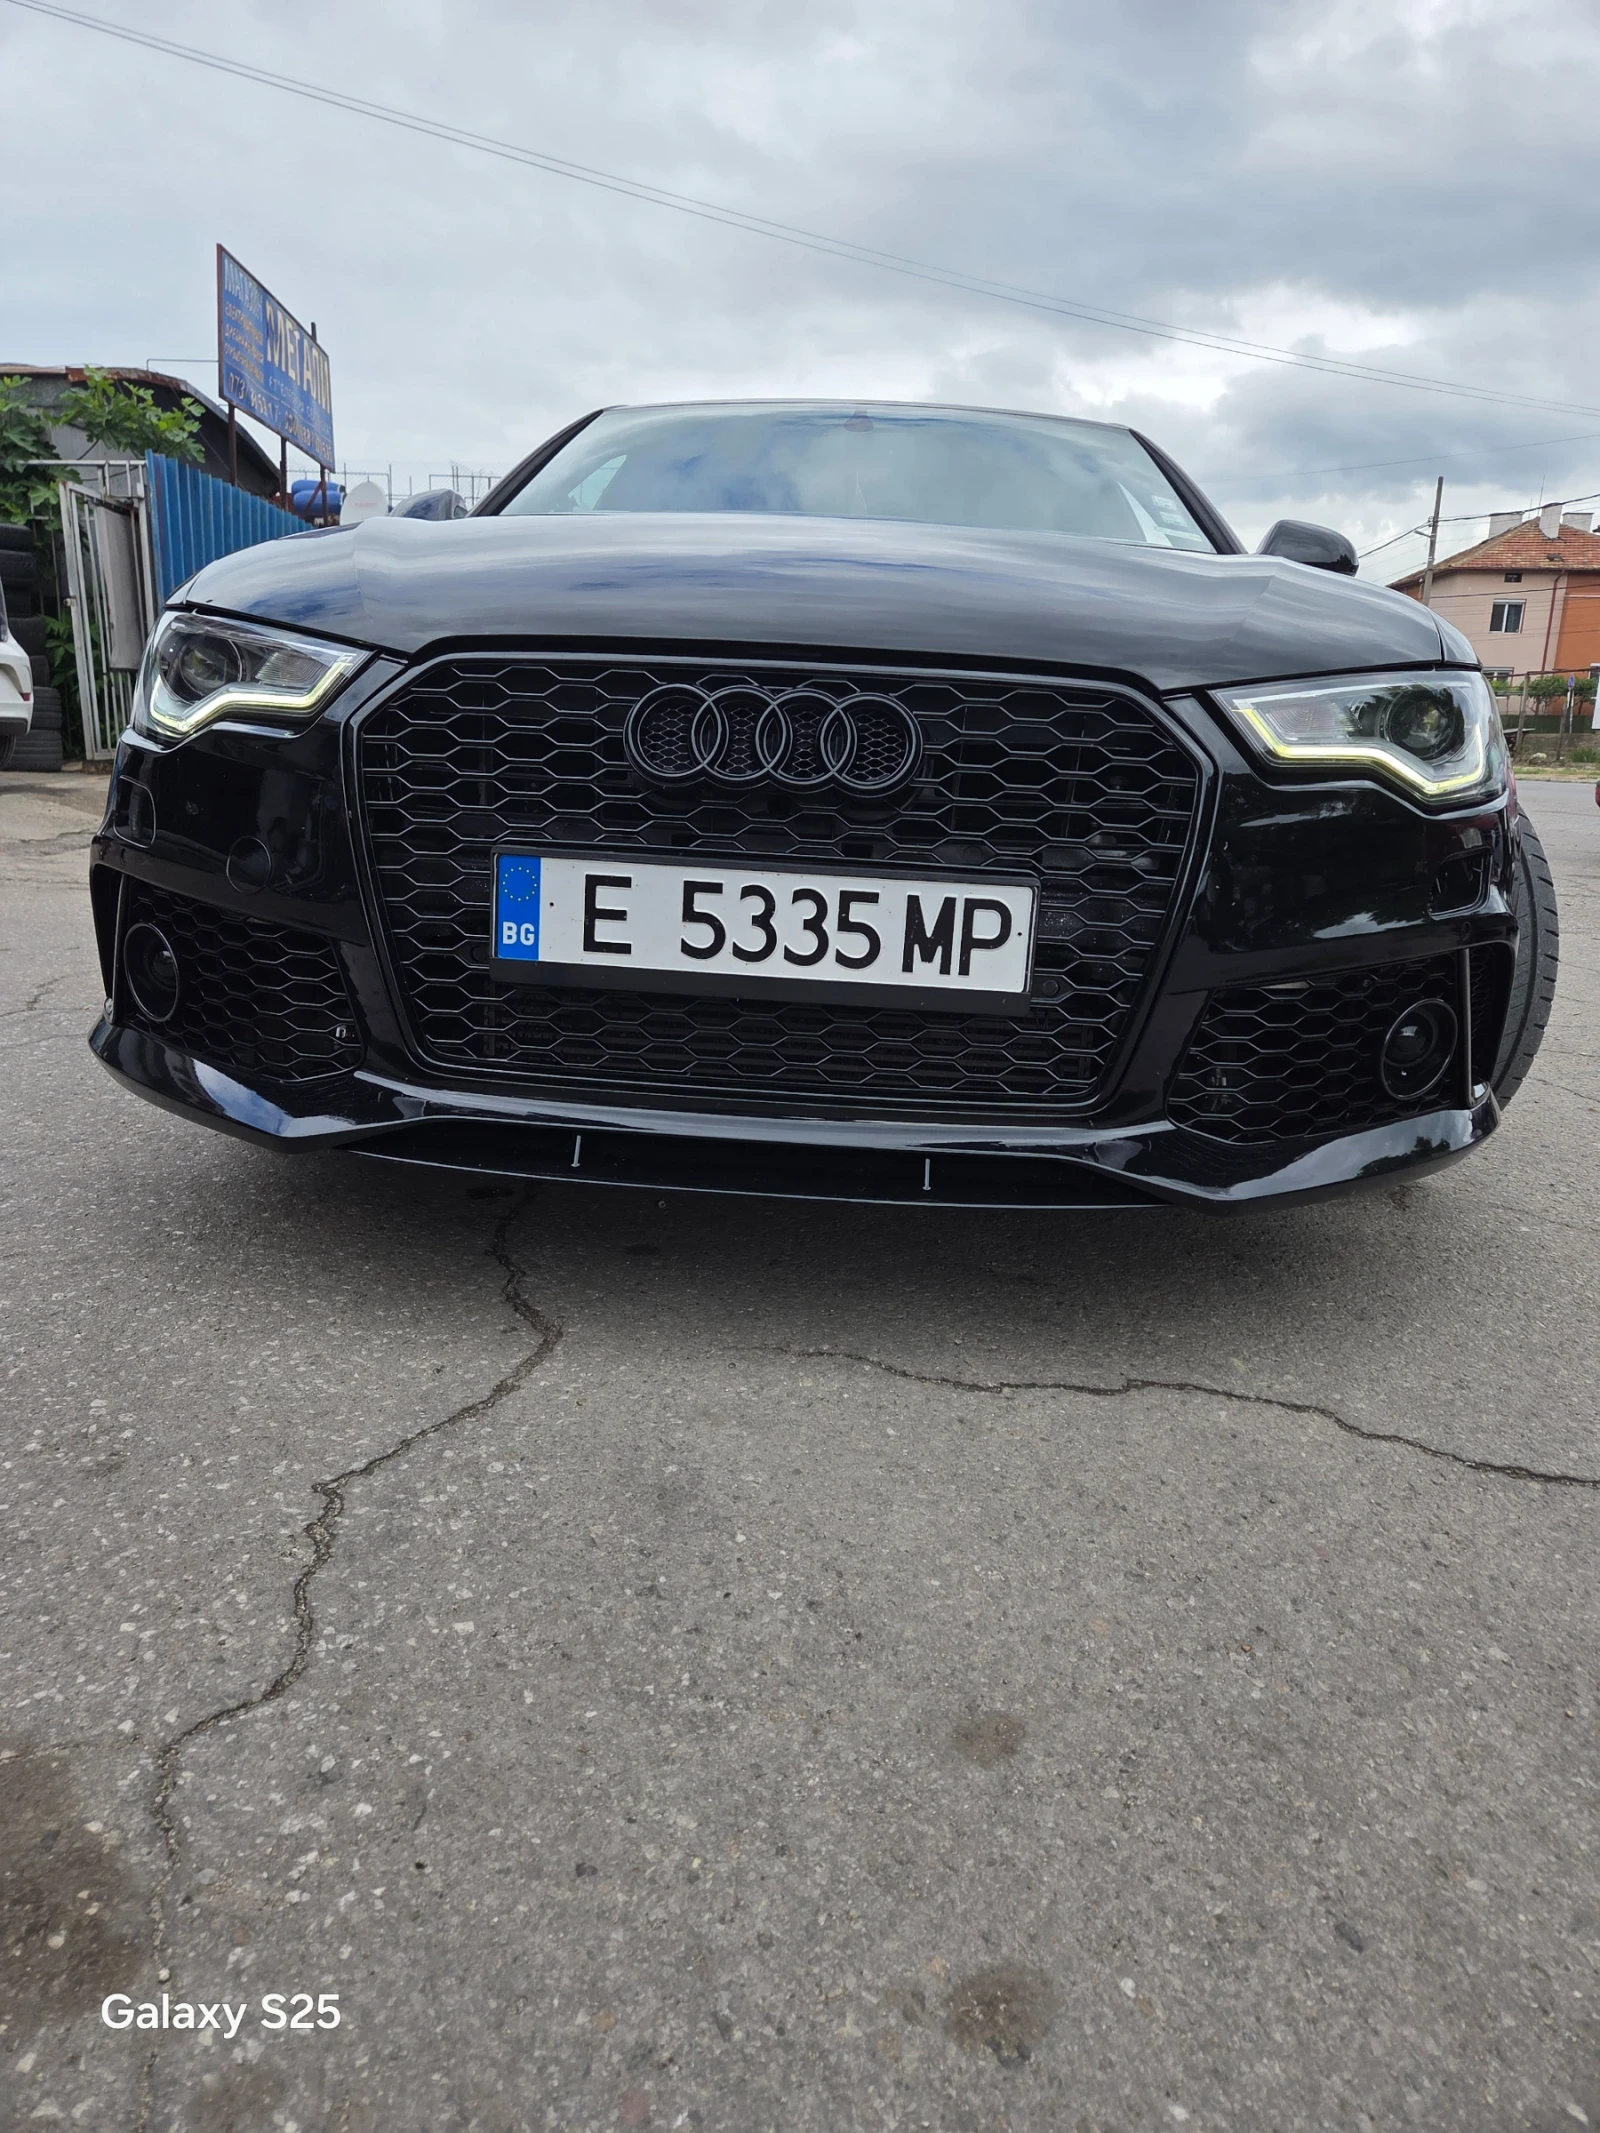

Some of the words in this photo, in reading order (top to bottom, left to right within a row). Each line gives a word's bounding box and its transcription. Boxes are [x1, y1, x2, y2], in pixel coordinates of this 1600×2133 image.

[502, 921, 536, 945] BG
[583, 873, 632, 955] E
[680, 880, 882, 970] 5335
[901, 893, 1013, 977] MP
